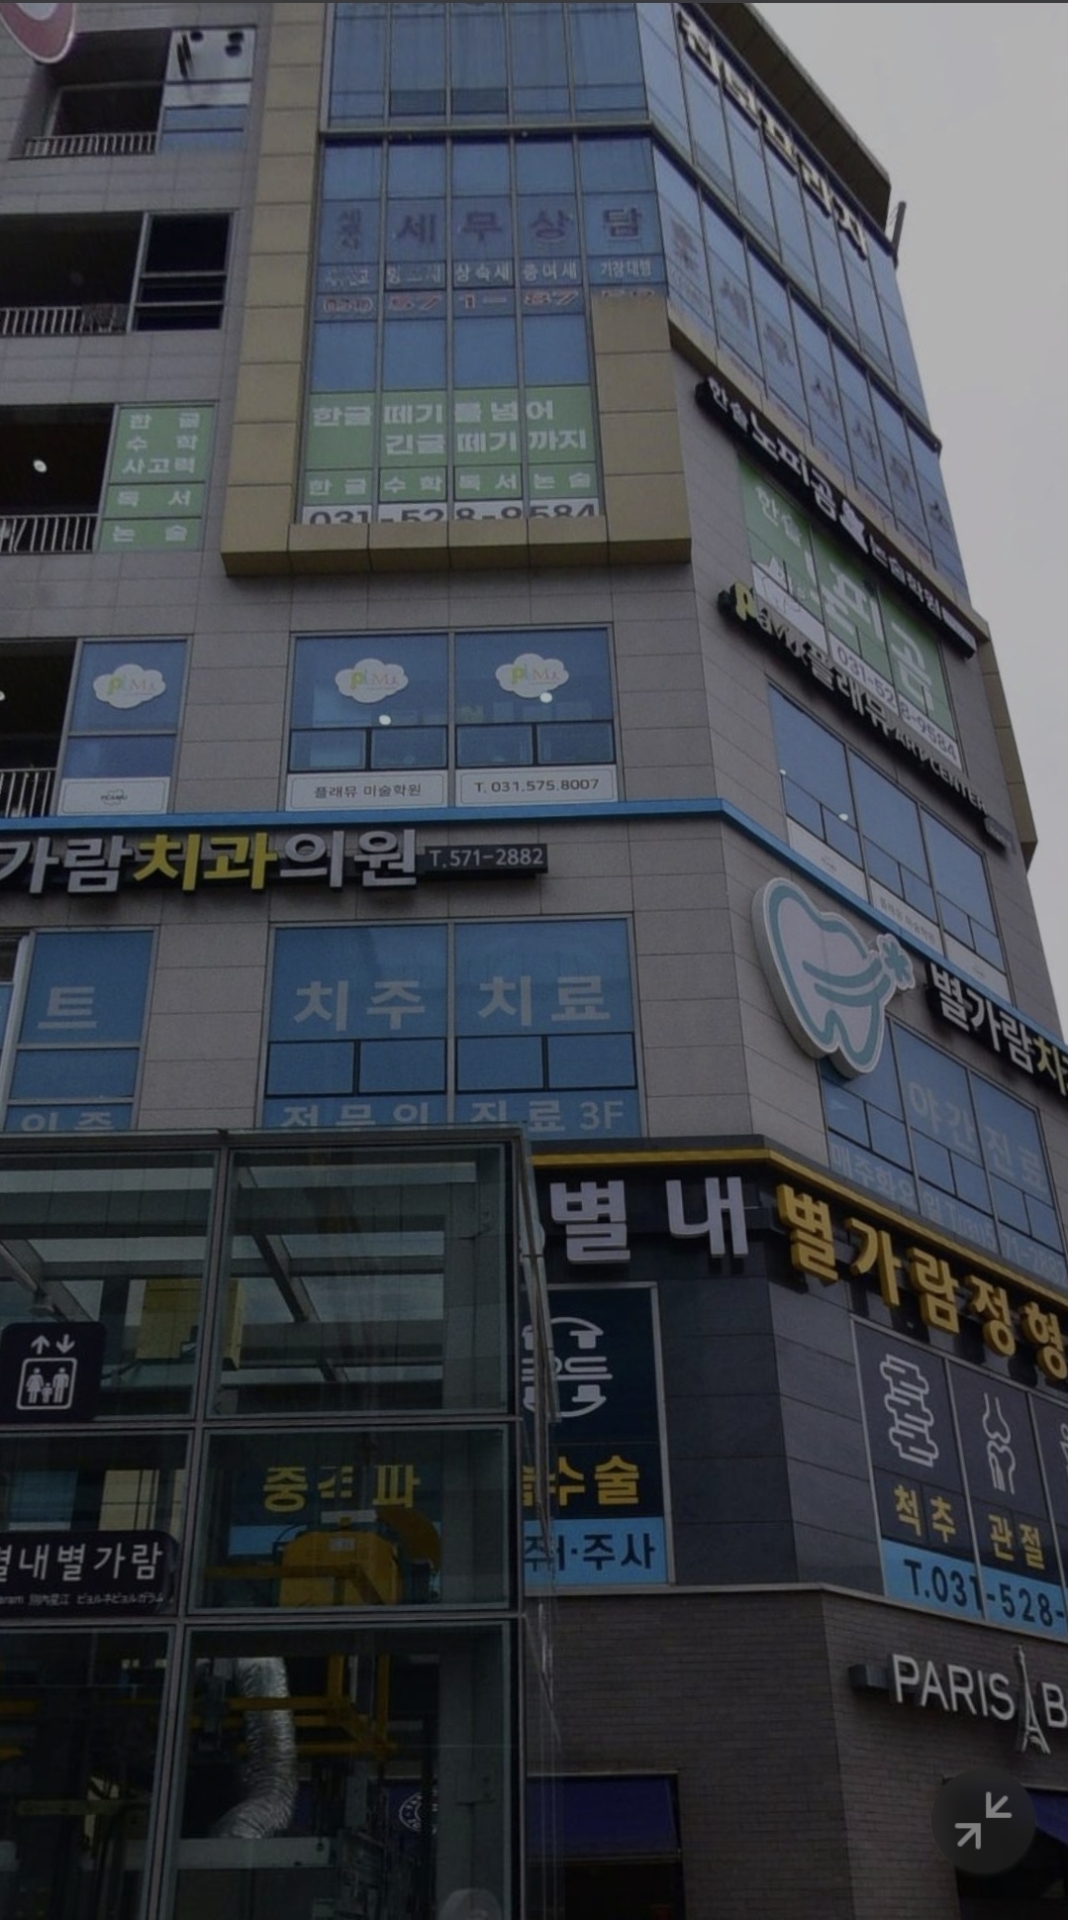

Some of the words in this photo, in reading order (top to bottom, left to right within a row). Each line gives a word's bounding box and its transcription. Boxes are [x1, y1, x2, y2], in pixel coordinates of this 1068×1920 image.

[313, 405, 372, 428] 한글
[309, 501, 596, 525] 031-528-9584
[836, 645, 959, 759] 031-528-9584
[314, 785, 358, 799] 플래뮤
[363, 783, 422, 798] 미술학원
[491, 778, 600, 793] 031.575.8007
[428, 847, 544, 869] T.571-2882
[37, 986, 98, 1030] 트
[293, 979, 428, 1032] 치주
[477, 975, 612, 1028] 치료
[929, 960, 1068, 1098] 별가람치
[580, 1100, 624, 1131] 3F
[522, 1454, 640, 1507] 수술
[893, 1484, 956, 1543] 척추
[988, 1513, 1046, 1571] 관절
[892, 1653, 1016, 1721] PARIS
[1041, 1681, 1068, 1729] B
